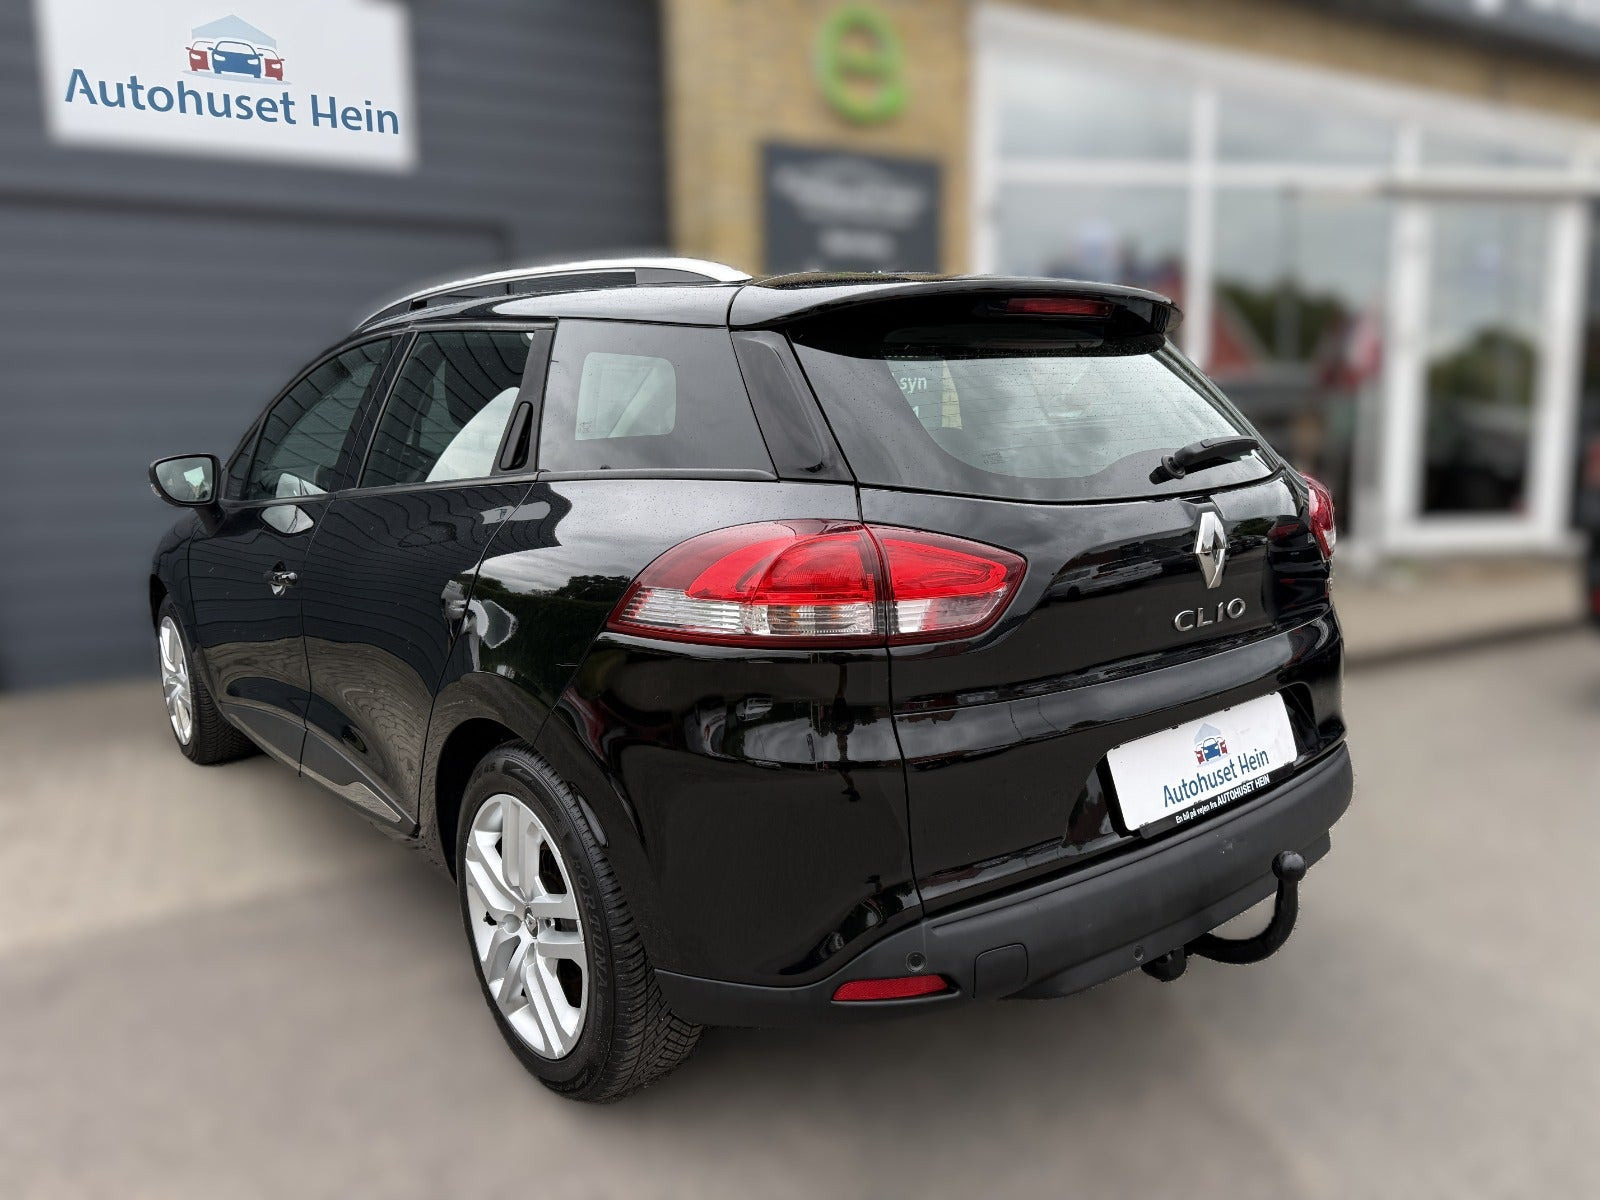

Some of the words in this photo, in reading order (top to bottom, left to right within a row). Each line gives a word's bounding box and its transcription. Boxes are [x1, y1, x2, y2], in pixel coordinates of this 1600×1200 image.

[64, 68, 297, 125] Autohuset
[310, 94, 400, 135] Hein
[1174, 597, 1246, 632] CLIO
[1163, 759, 1238, 807] Autohuset
[1237, 748, 1270, 775] Hein
[1175, 815, 1184, 824] En
[1182, 811, 1190, 821] bil
[1189, 808, 1197, 819] på
[1196, 804, 1210, 815] vejen
[1209, 801, 1218, 810] fra
[1217, 780, 1255, 807] AUTOHUSET
[1254, 773, 1271, 789] HEIN
